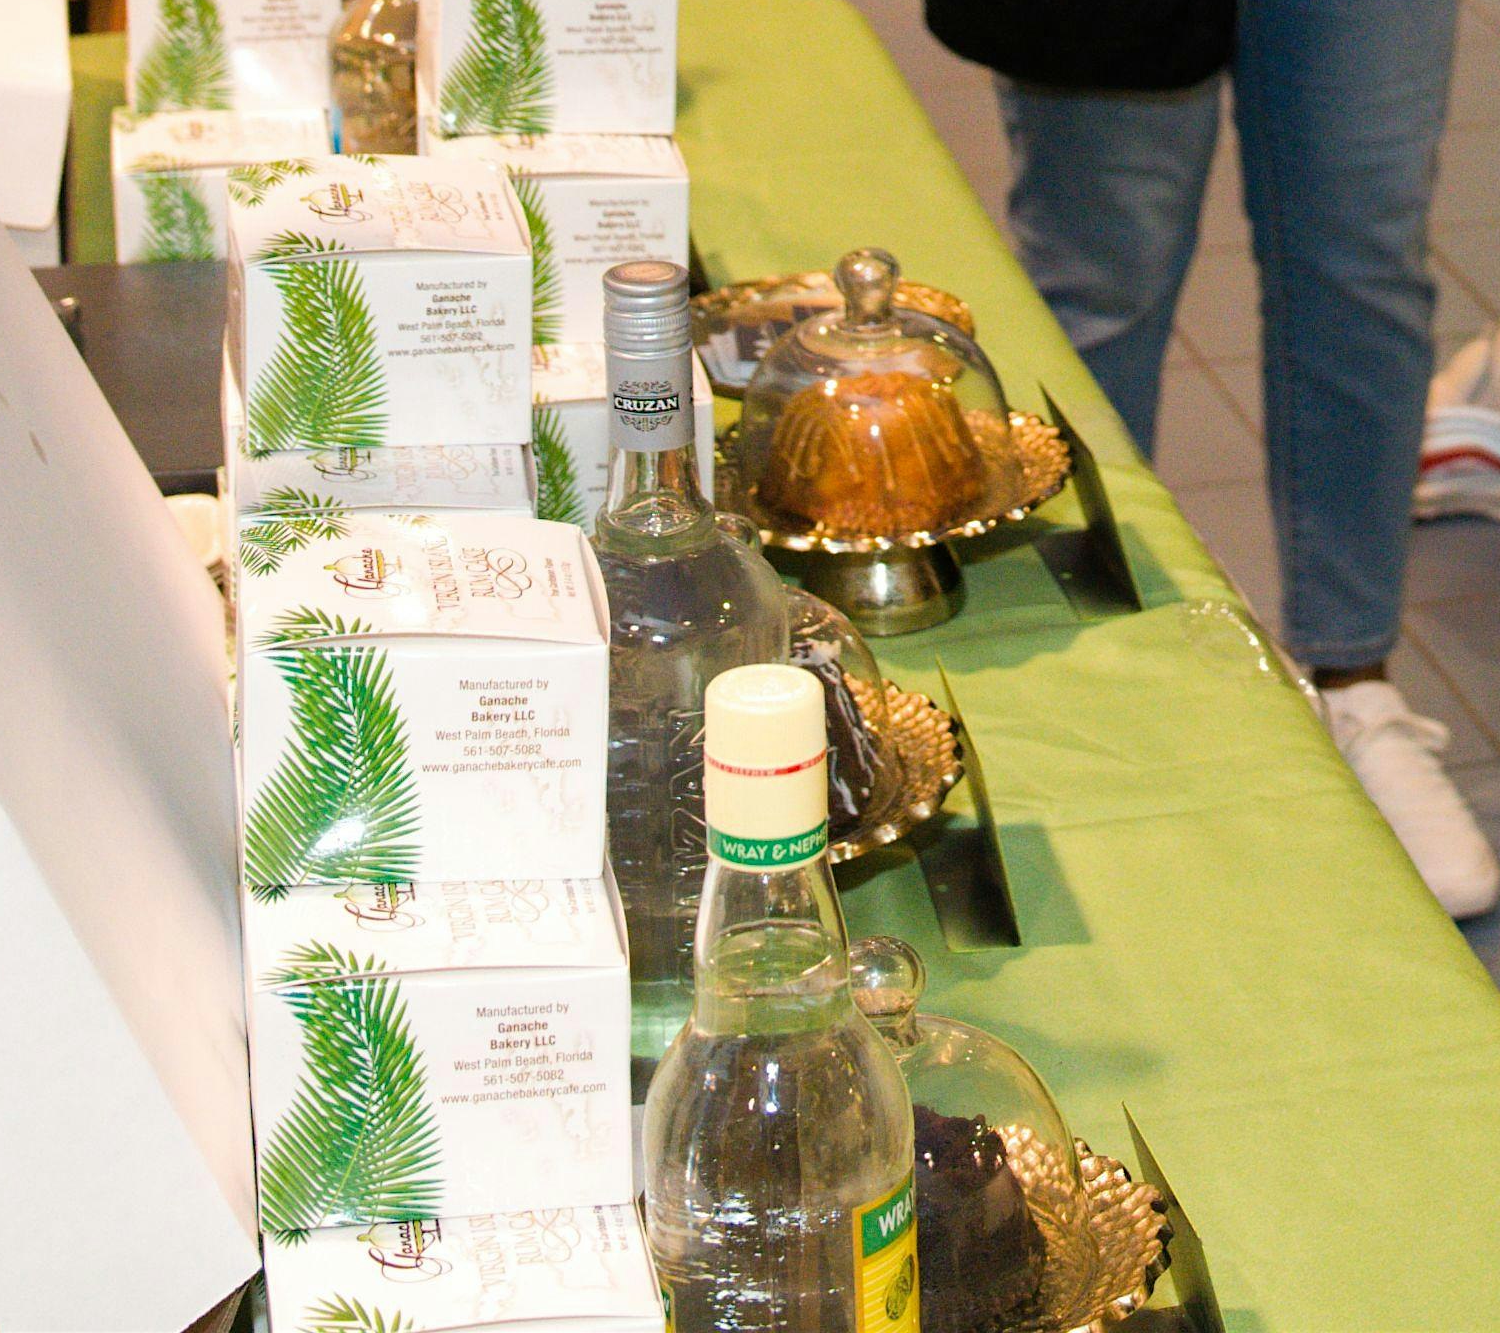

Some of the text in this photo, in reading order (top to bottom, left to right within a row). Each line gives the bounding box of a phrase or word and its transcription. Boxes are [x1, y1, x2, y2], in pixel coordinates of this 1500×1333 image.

[614, 396, 678, 412] CRUZAN
[459, 678, 549, 691] Manufactured by
[479, 695, 529, 706] Ganache
[471, 710, 536, 723] Bakery LLC
[435, 730, 462, 741] West
[465, 729, 491, 740] Palm
[534, 727, 571, 738] Florida
[463, 744, 542, 756] 561-507-5082
[422, 758, 582, 774] www.ganachebakerycafe.com
[722, 838, 768, 861] WRAY
[771, 843, 788, 861] &
[476, 1001, 570, 1018] Manufactured by
[497, 1020, 549, 1034] Ganache
[490, 1035, 556, 1050] Bakery LLC
[453, 1060, 480, 1071] West
[484, 1058, 511, 1070] Palm
[555, 1050, 593, 1063] Florida
[483, 1069, 564, 1086] 561-507-5082
[440, 1083, 607, 1104] www.ganachebakerycafe.com
[468, 1214, 497, 1234] ISL
[515, 1230, 544, 1266] RUM
